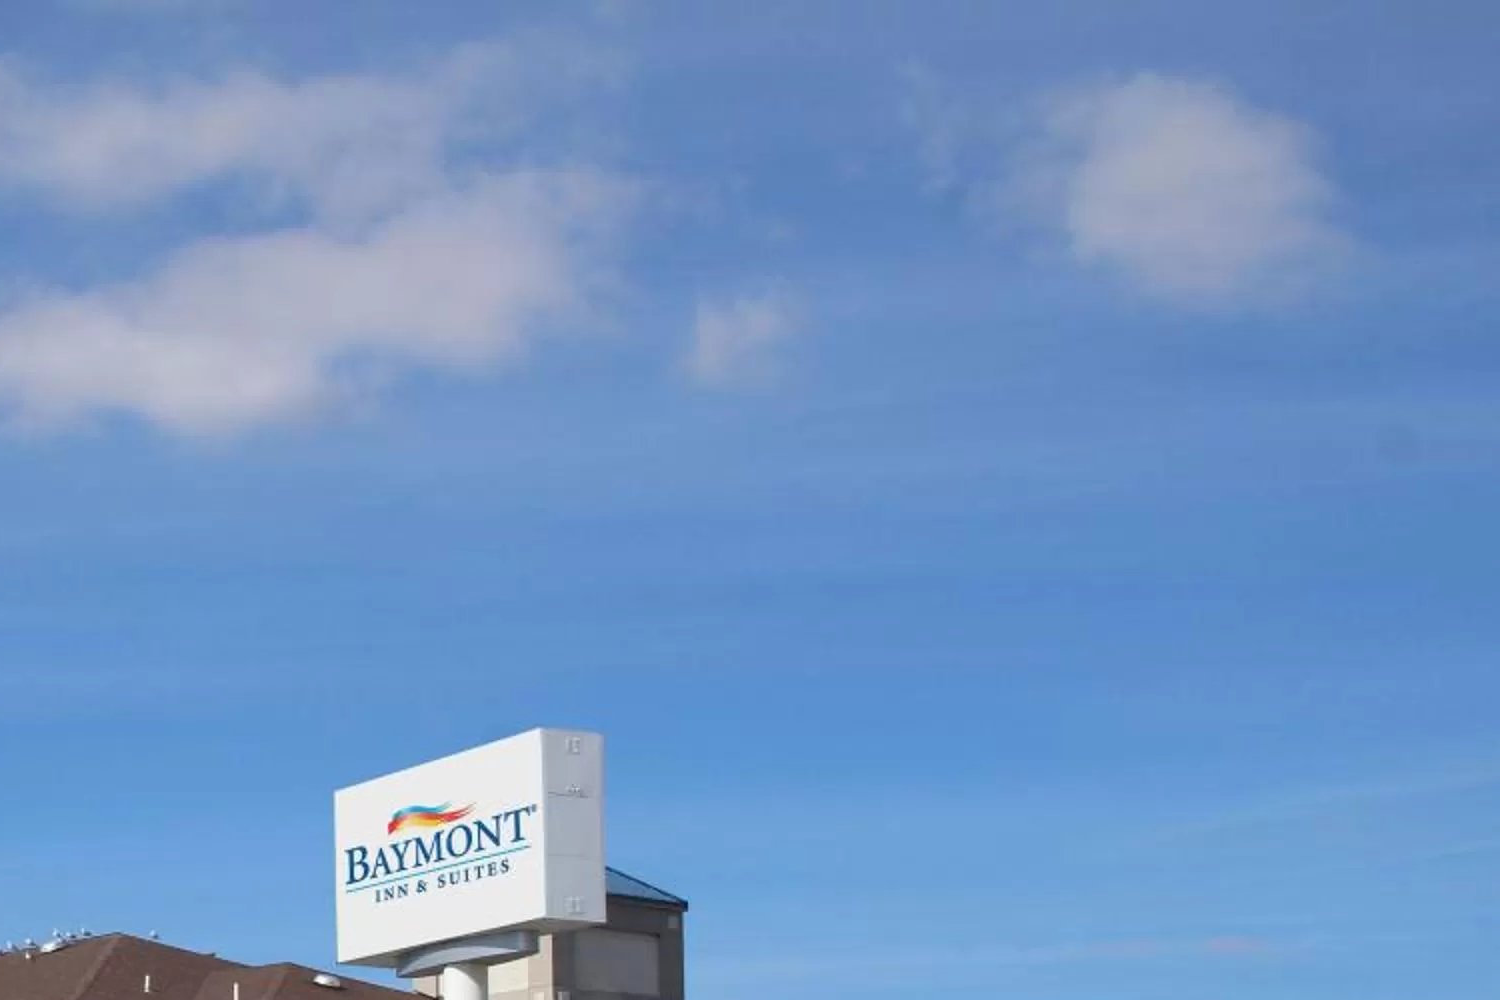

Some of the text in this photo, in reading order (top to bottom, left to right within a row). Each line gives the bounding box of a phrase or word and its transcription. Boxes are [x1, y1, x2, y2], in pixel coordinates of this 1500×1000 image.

[344, 806, 530, 884] BAYMONT
[375, 858, 509, 902] INN & SUITES
